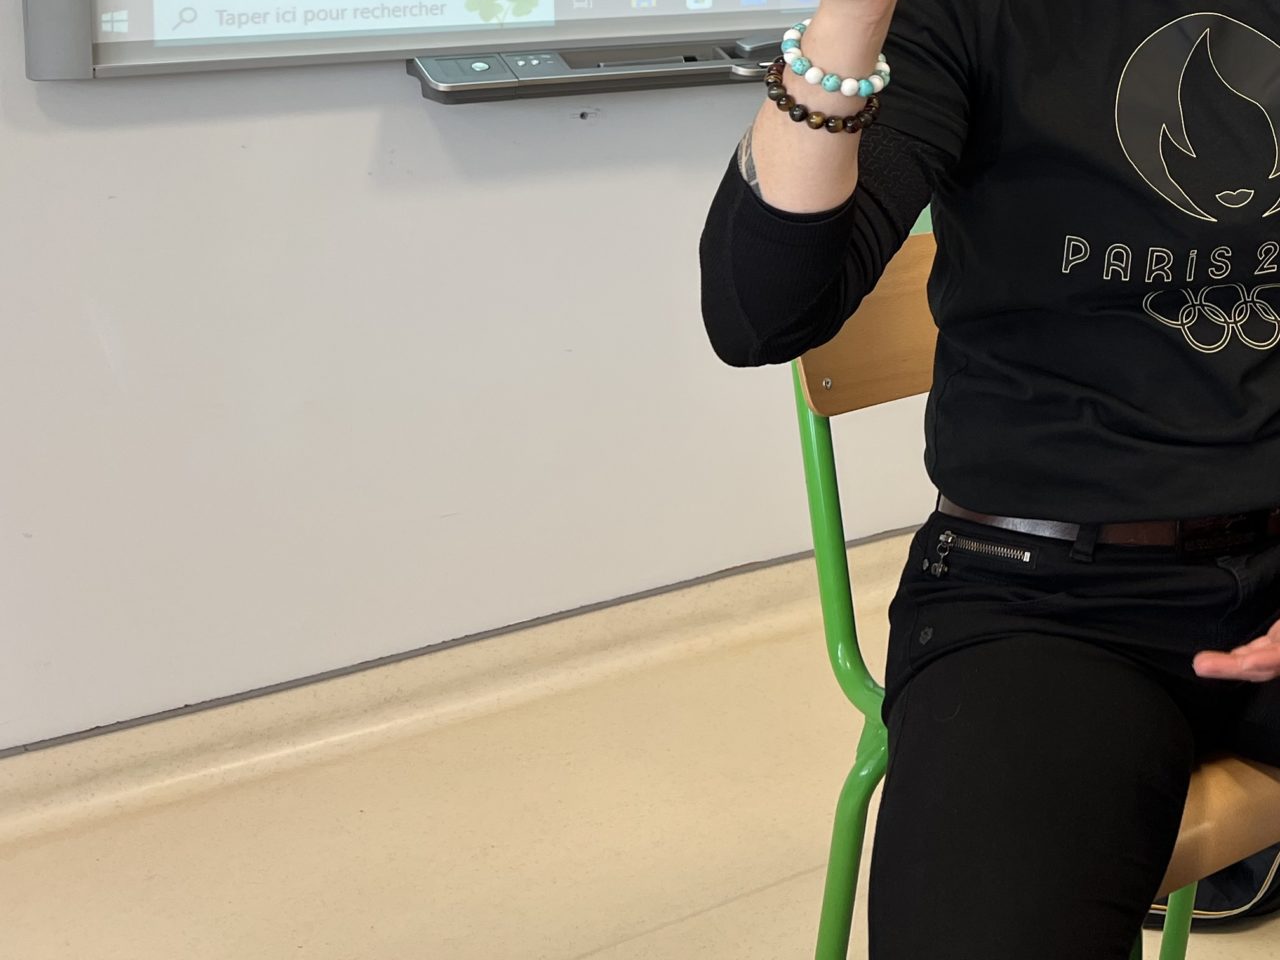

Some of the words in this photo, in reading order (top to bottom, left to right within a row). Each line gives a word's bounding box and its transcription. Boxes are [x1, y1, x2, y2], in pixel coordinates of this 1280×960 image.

[215, 9, 270, 27] Taper
[275, 7, 297, 23] ici
[303, 8, 347, 27] pour
[352, 2, 447, 21] rechercher
